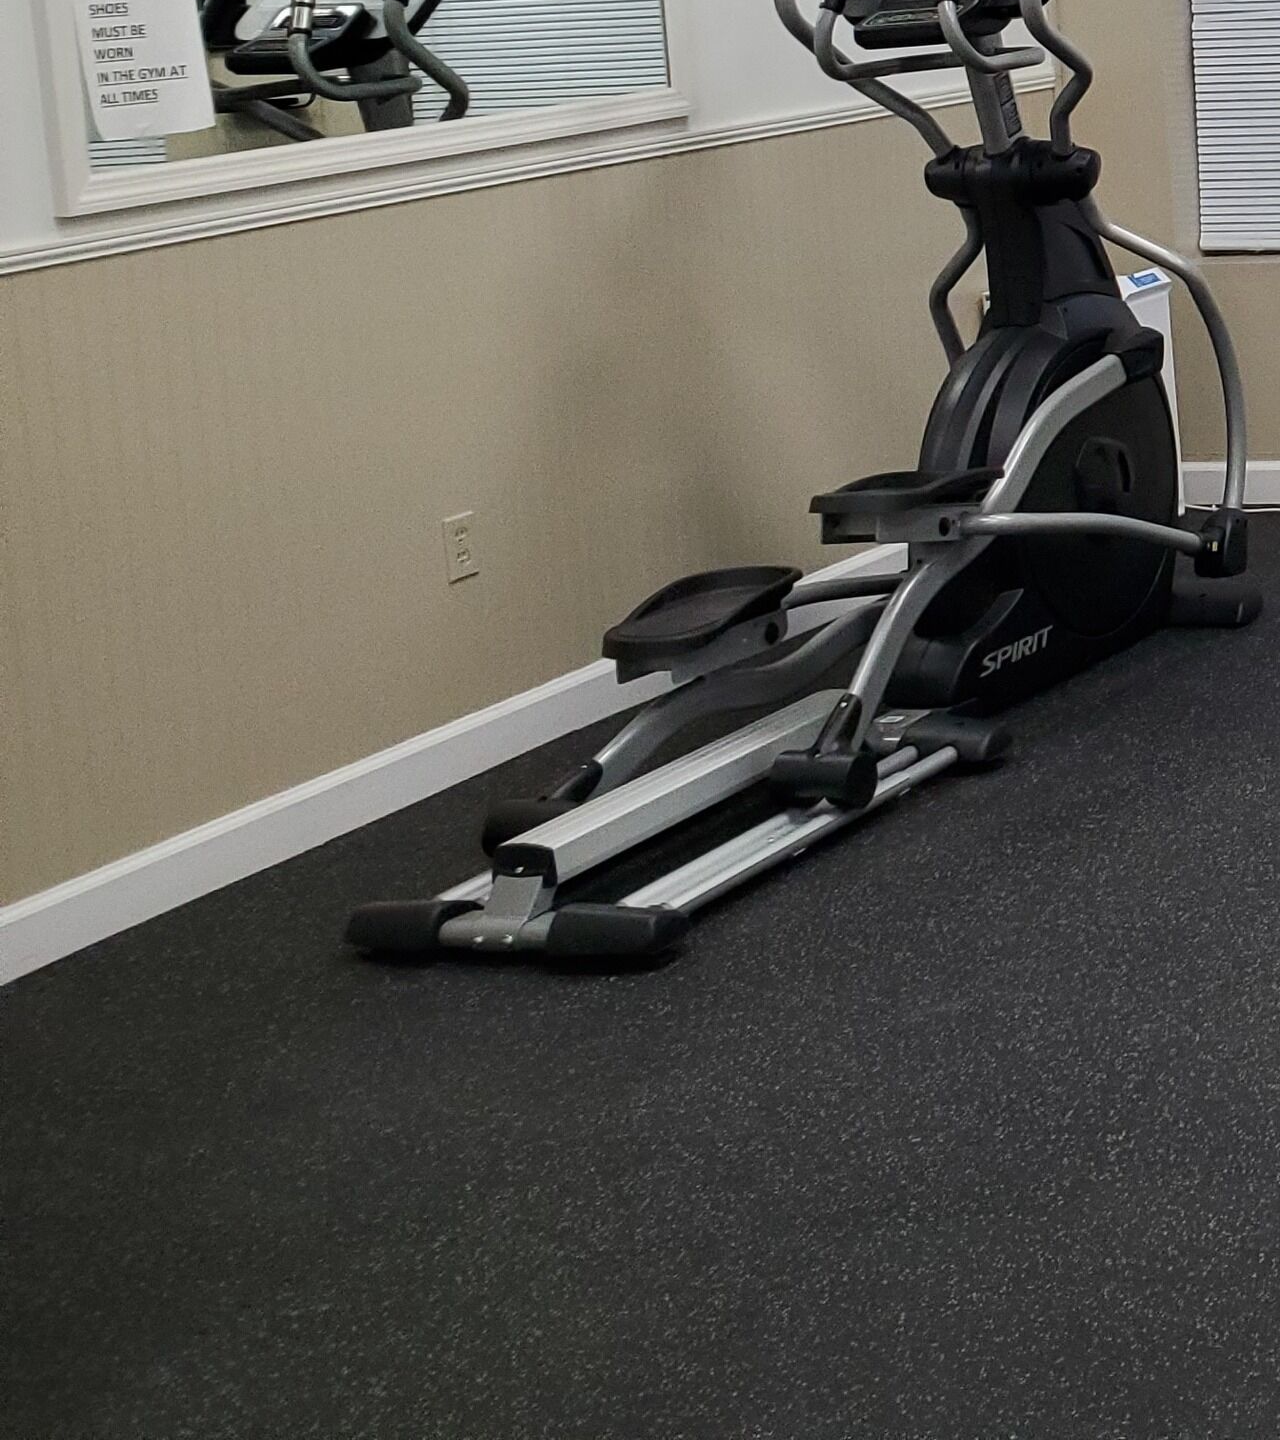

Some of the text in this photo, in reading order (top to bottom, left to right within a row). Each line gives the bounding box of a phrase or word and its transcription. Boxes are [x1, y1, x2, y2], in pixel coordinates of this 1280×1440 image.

[89, 2, 129, 15] SHOES
[92, 24, 146, 38] MUST BE
[94, 47, 133, 60] WORN
[97, 65, 187, 83] IN THE GYM AT
[100, 89, 158, 105] ALL TIMES
[980, 625, 1053, 677] SPIRIT
